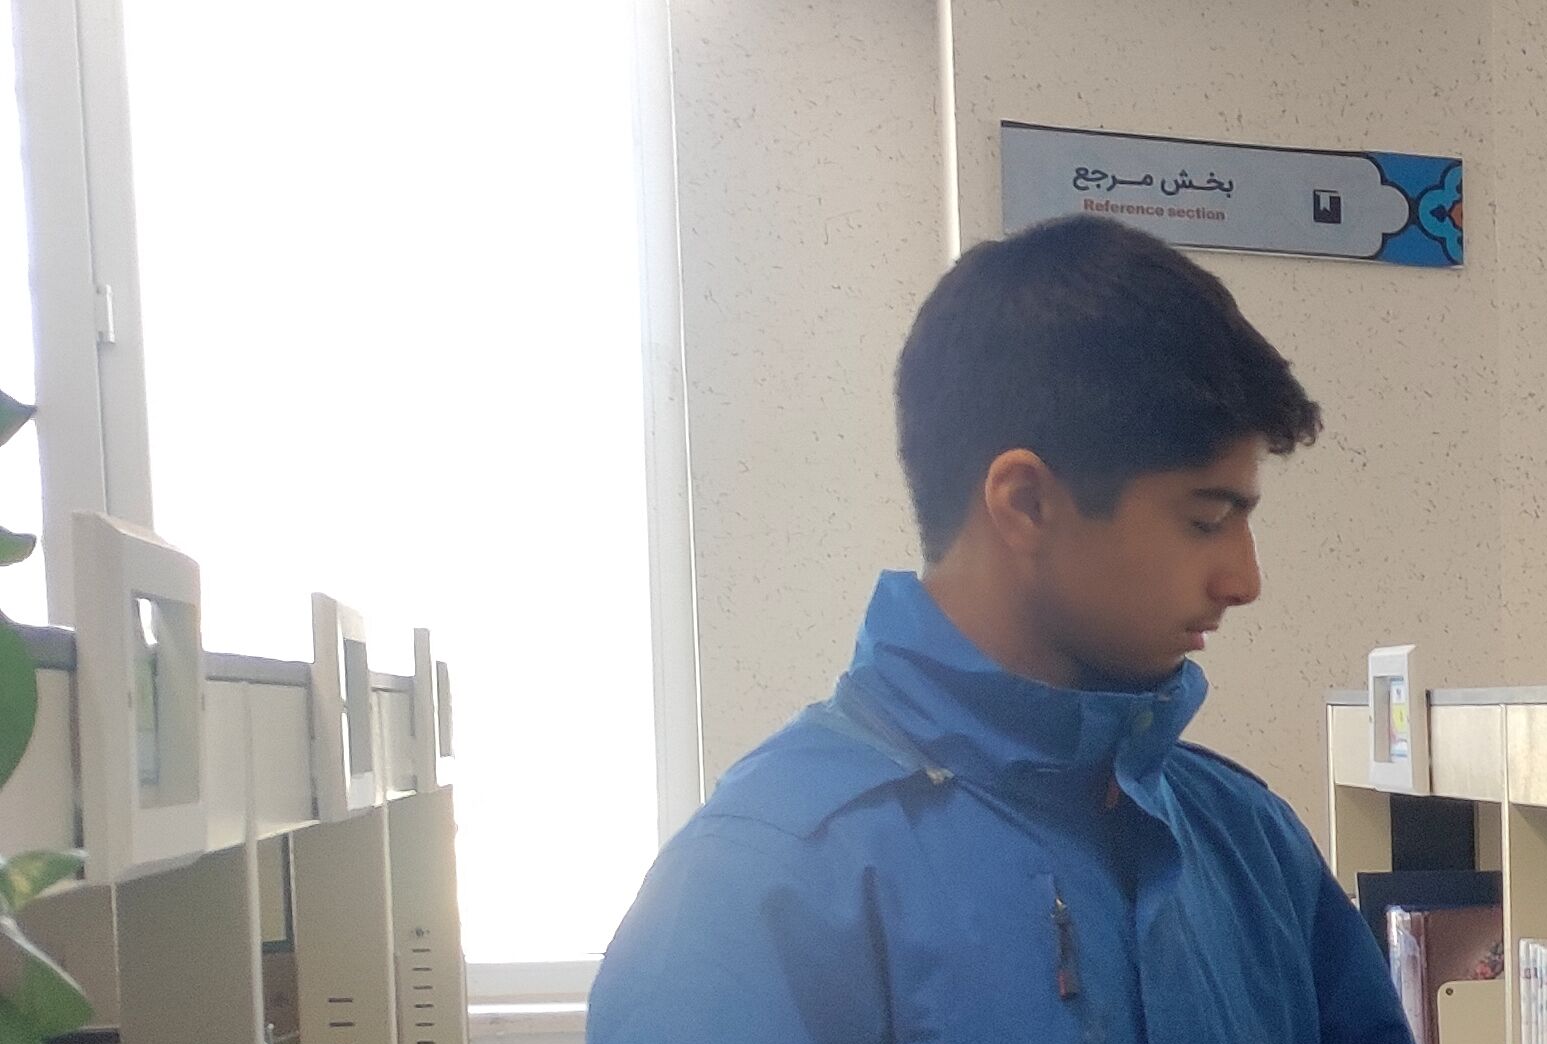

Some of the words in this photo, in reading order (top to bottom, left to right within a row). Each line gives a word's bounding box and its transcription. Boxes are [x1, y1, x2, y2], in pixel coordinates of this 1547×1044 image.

[1072, 164, 1153, 191] مرجع
[1160, 169, 1234, 198] بخش
[1083, 198, 1166, 219] Reference
[1167, 206, 1226, 222] section
